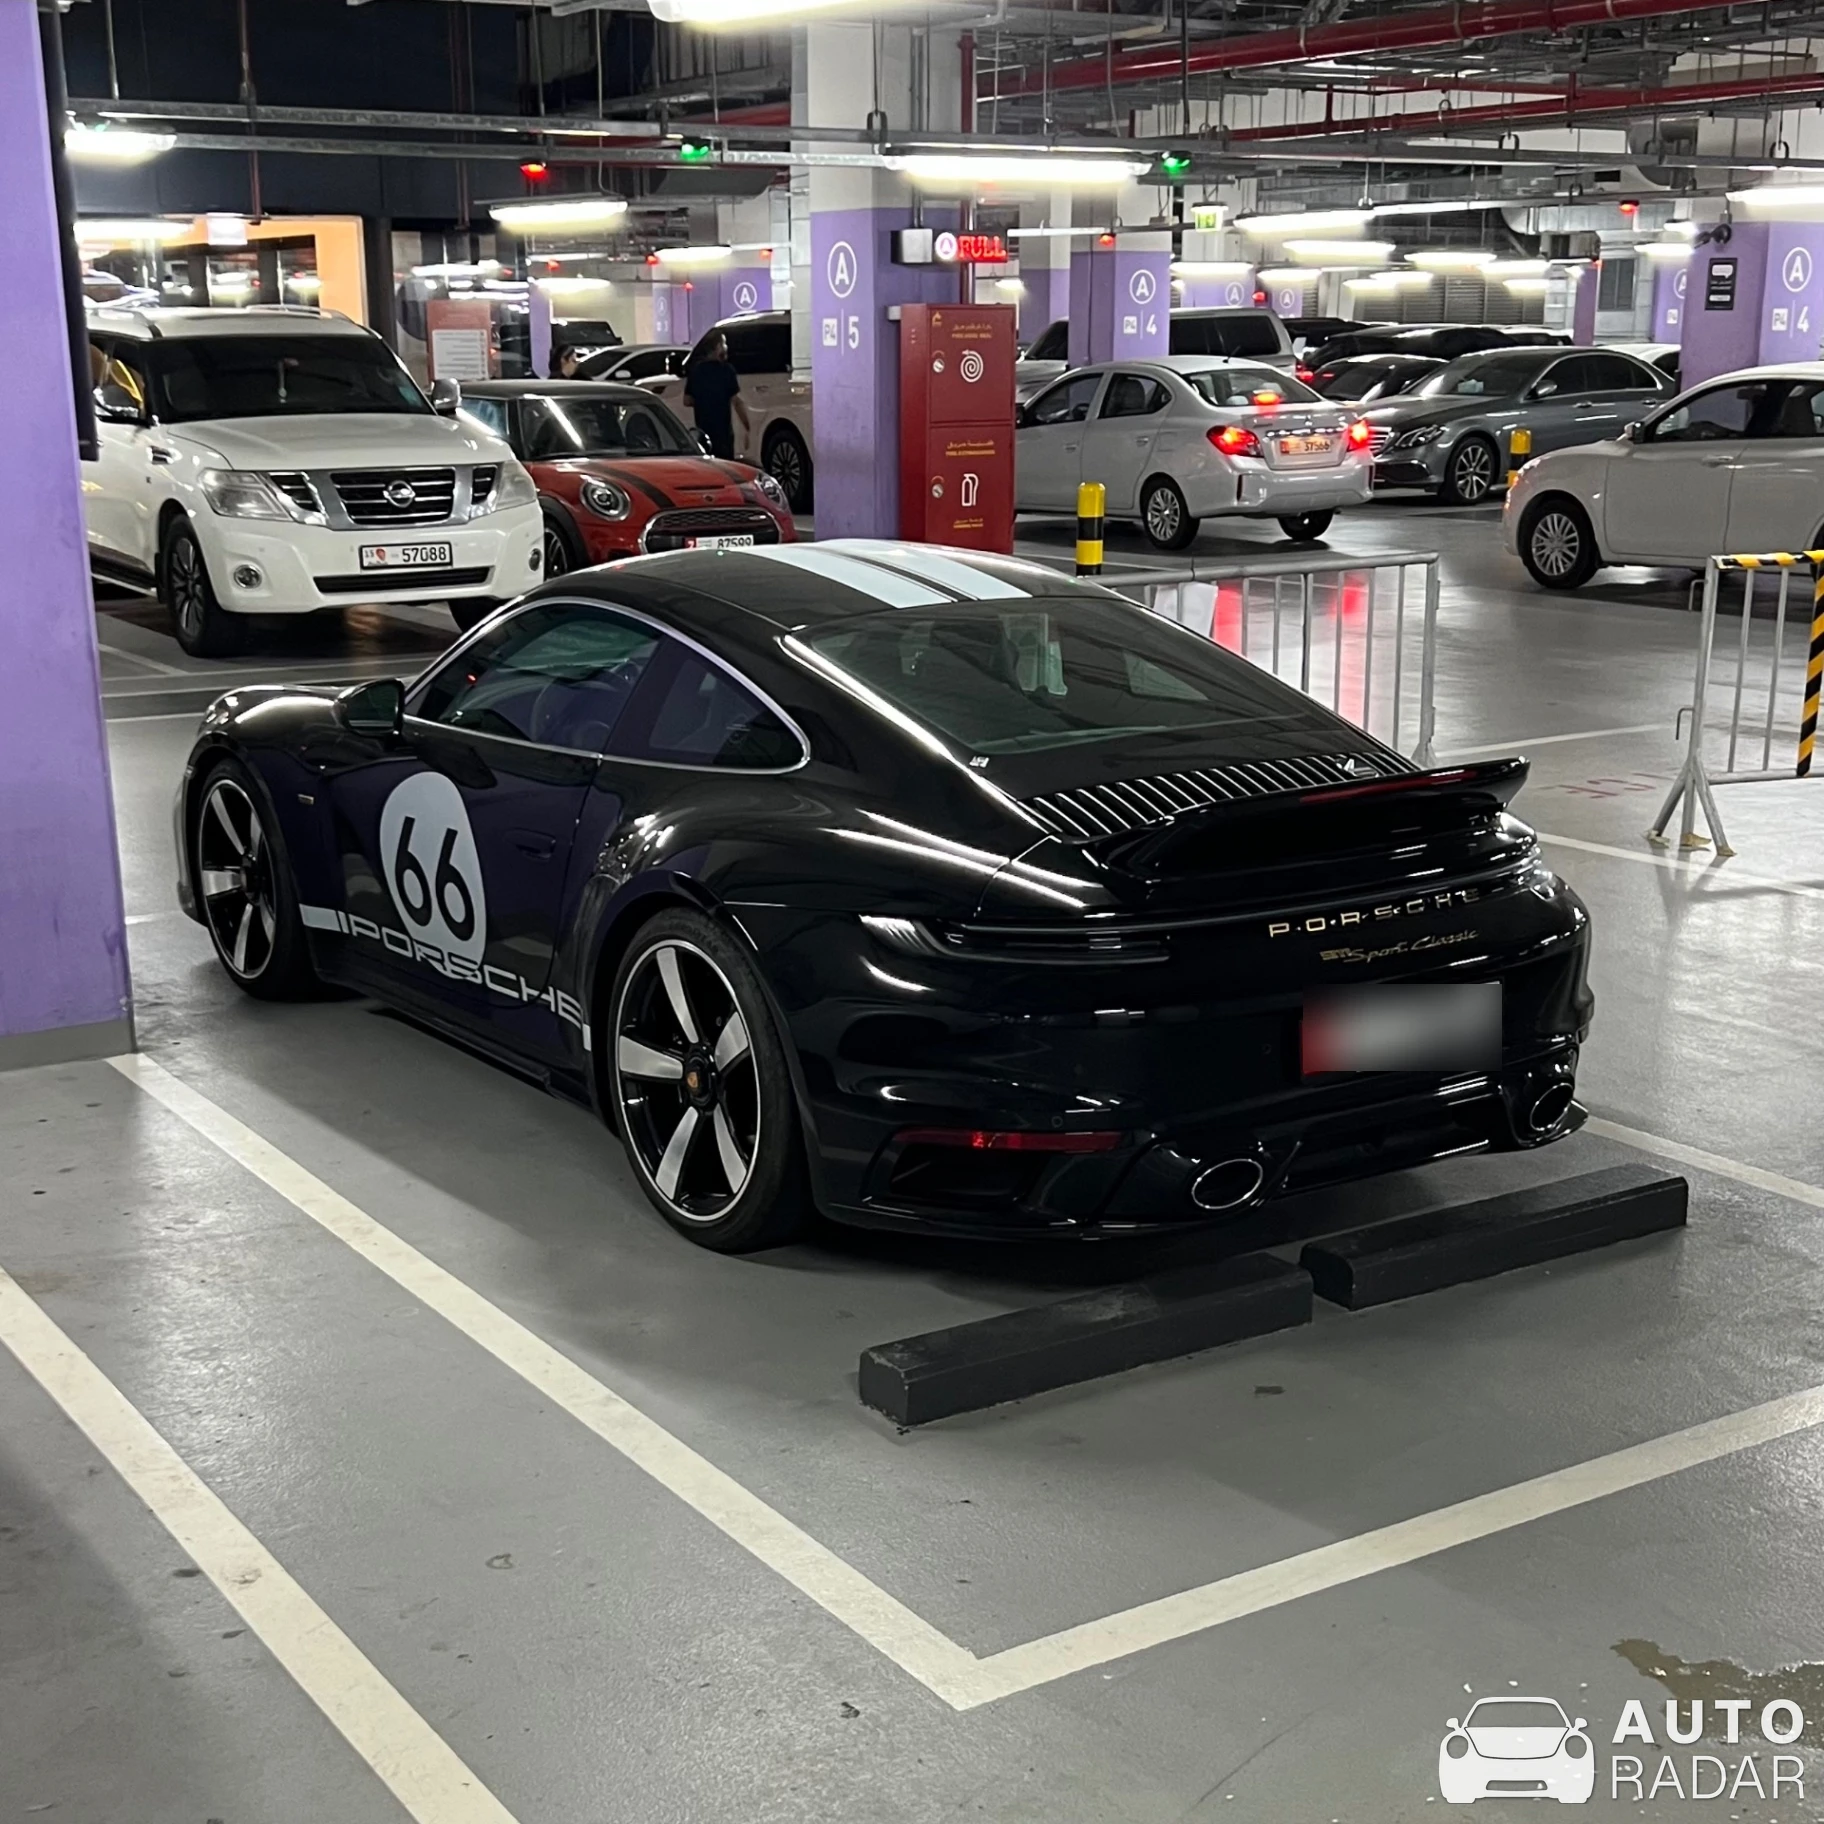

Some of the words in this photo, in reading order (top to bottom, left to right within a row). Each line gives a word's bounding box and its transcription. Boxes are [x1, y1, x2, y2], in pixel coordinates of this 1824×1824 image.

[958, 235, 1006, 259] FULL
[835, 252, 850, 286] A
[1789, 255, 1804, 282] A
[740, 287, 752, 304] A
[1136, 275, 1150, 297] A
[848, 315, 860, 349] 5
[1146, 314, 1158, 335] 4
[1797, 306, 1810, 332] 4
[402, 546, 447, 563] 57088
[395, 816, 475, 941] 66
[1343, 941, 1408, 963] Sport
[1411, 930, 1479, 951] Classic
[348, 913, 585, 1030] PORSCHE
